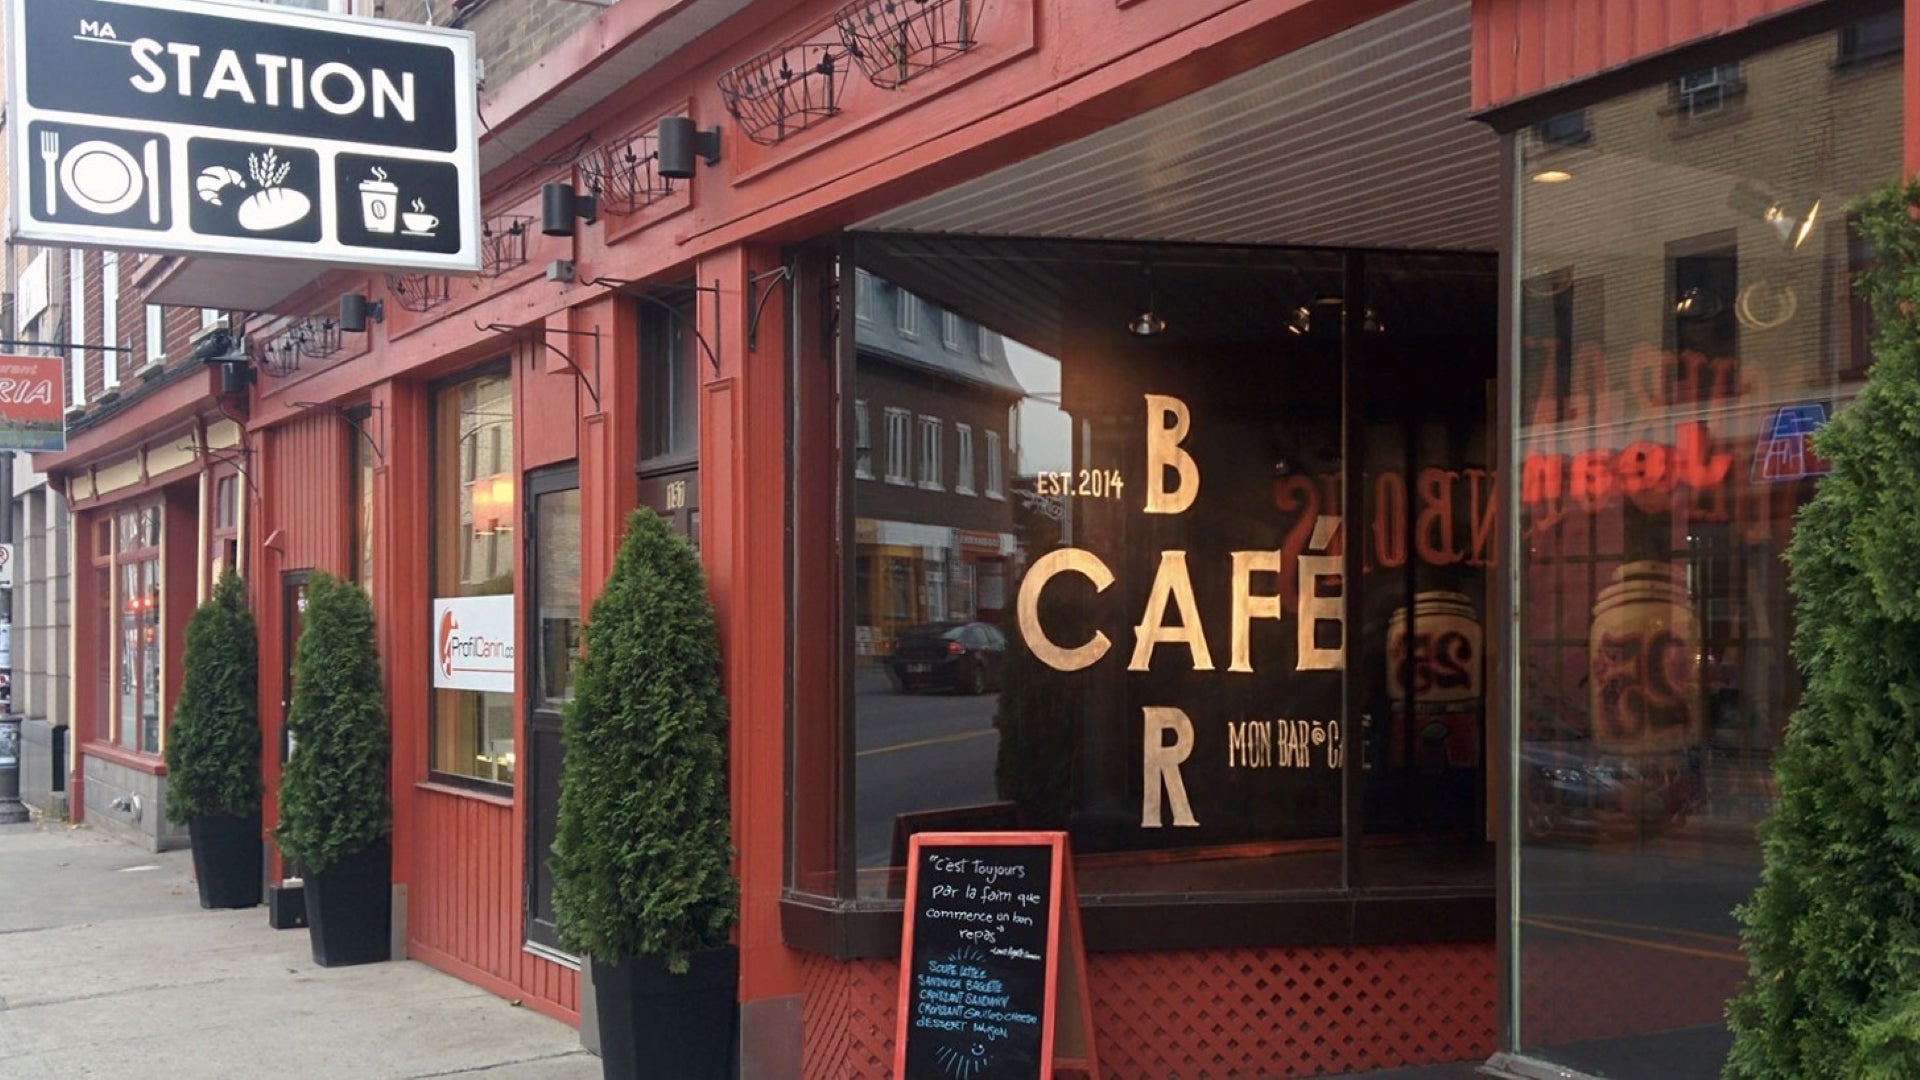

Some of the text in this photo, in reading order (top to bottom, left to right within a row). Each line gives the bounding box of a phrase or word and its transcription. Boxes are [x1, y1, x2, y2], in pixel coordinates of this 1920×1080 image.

[79, 19, 117, 39] MA
[129, 37, 415, 122] STATION
[1017, 515, 1344, 672] CAFÉ
[1228, 719, 1271, 768] MON
[932, 884, 1041, 908] par la faim que
[925, 908, 1033, 926] commence un bon
